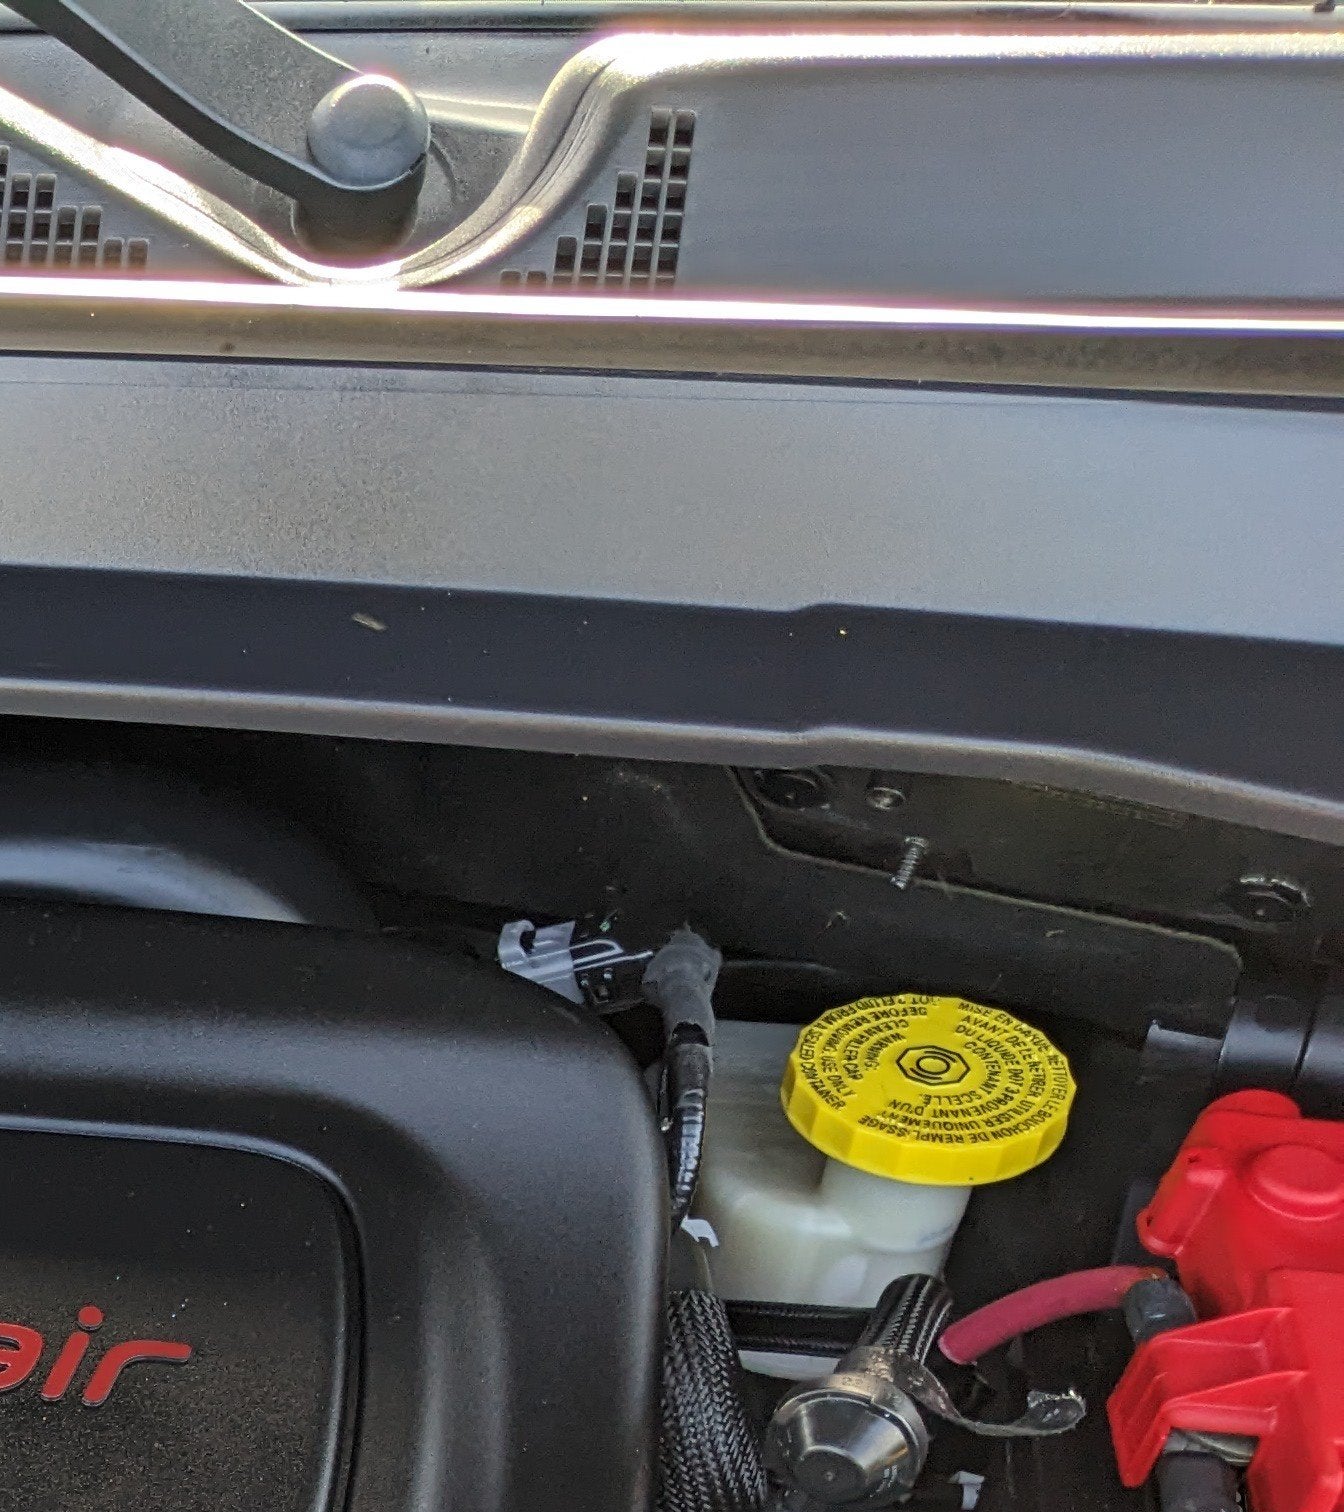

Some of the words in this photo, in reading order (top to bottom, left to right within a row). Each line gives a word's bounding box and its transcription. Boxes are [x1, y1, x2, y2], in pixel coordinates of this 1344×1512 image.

[867, 1007, 927, 1020] BEFORE
[993, 1013, 1016, 1025] EN
[954, 1023, 978, 1037] DU
[961, 1012, 1010, 1037] AVANT
[976, 1032, 1020, 1065] LIQUIDE
[1003, 1034, 1027, 1048] DE
[1017, 1048, 1038, 1059] LE
[820, 1055, 839, 1072] USE
[842, 1062, 866, 1081] CAP
[961, 1040, 1001, 1095] CONTENANT
[824, 1074, 858, 1098] ONLY
[1008, 1068, 1024, 1087] DOT
[885, 1098, 924, 1116] D'UN
[931, 1092, 1016, 1118] PROVENANT
[980, 1099, 1036, 1127] UTILISER
[876, 1109, 983, 1130] UNIQUEMENT
[988, 1108, 1054, 1140] BOUCHON
[966, 1132, 991, 1142] DE
